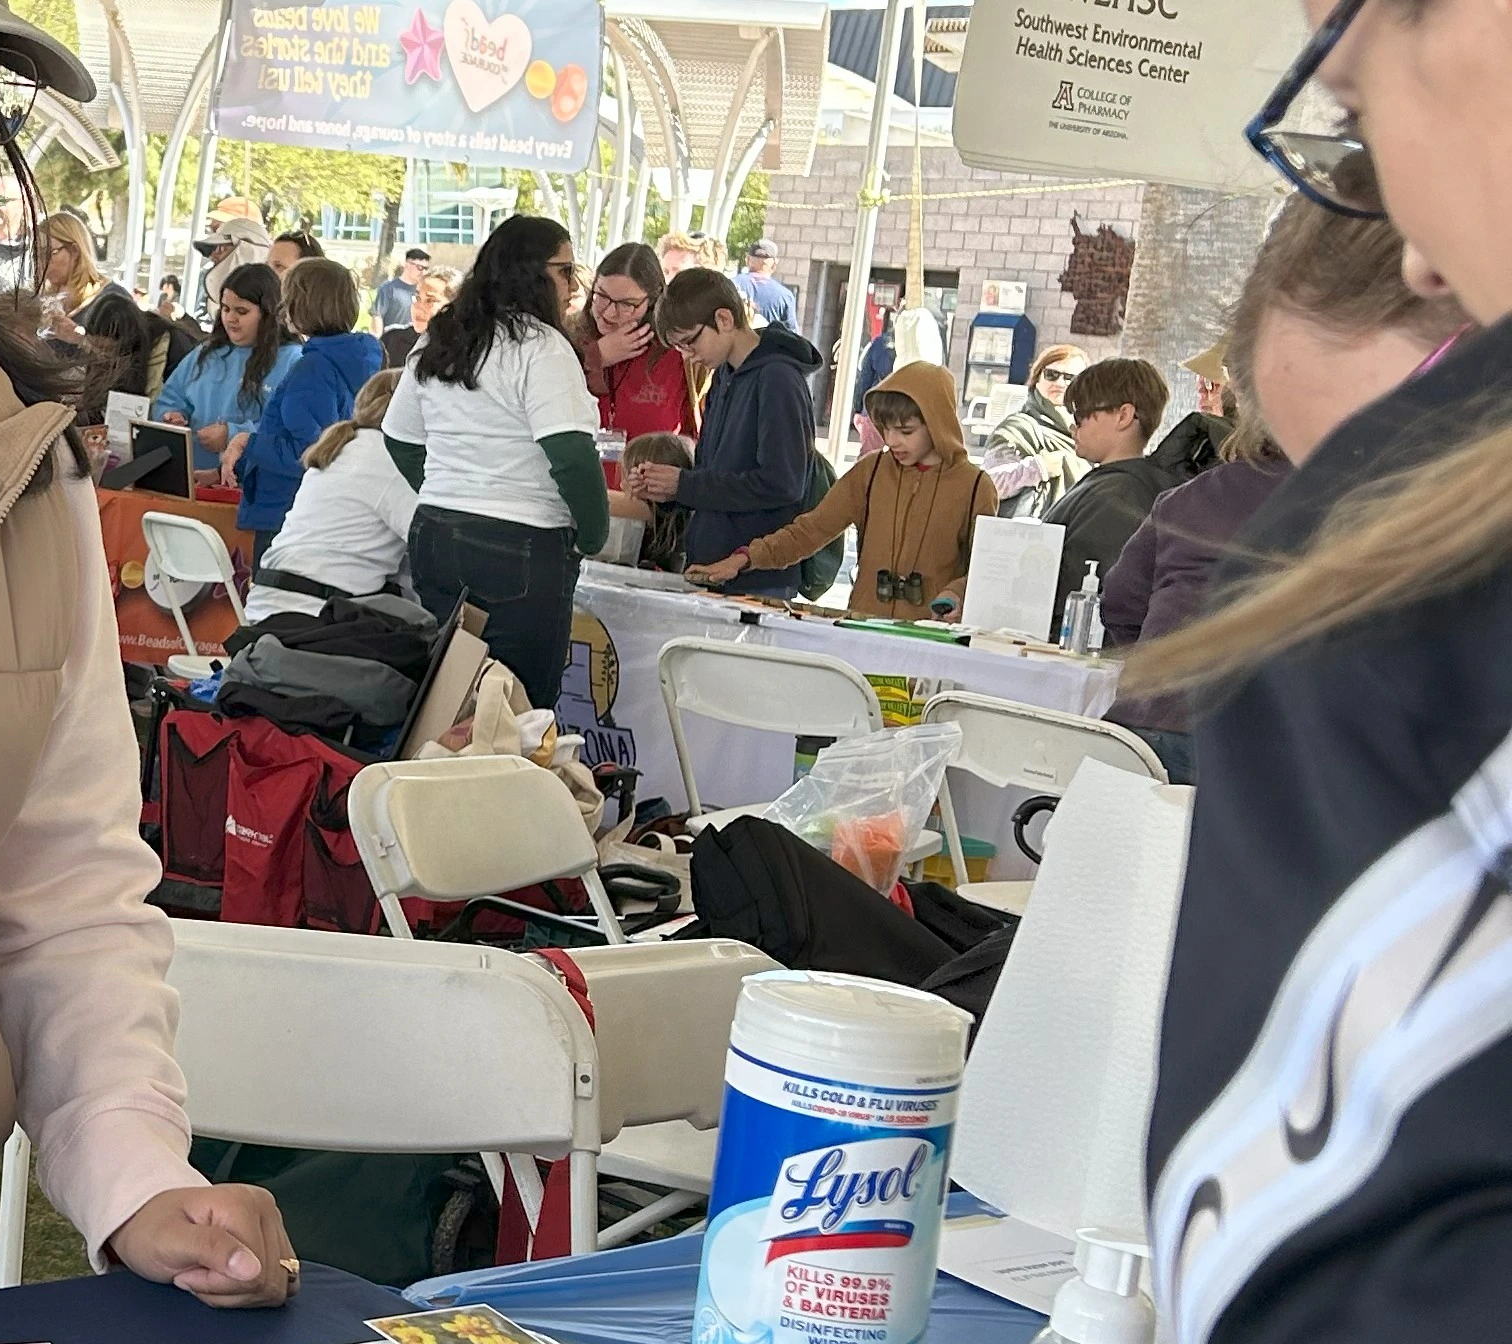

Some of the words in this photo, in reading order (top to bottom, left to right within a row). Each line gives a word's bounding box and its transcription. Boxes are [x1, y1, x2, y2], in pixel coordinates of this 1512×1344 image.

[1014, 8, 1088, 41] Southwest
[1092, 23, 1203, 61] Environmental
[1015, 35, 1063, 64] Health
[1066, 46, 1133, 76] Sciences
[1138, 58, 1190, 84] Center
[1077, 87, 1117, 104] COLLEGE
[1119, 95, 1132, 106] OF
[1078, 102, 1130, 120] PHARMACY
[782, 1081, 819, 1099] KILLS
[820, 1090, 856, 1106] COLD
[857, 1097, 865, 1108] &
[868, 1098, 895, 1111] FLU
[896, 1099, 940, 1112] VIRUSES
[780, 1143, 928, 1232] Lysol
[786, 1264, 834, 1286] KILLS
[840, 1276, 892, 1292] 99.9%
[785, 1280, 809, 1295] OF
[814, 1287, 889, 1305] VIRUSES
[782, 1295, 794, 1309] &
[799, 1298, 889, 1320] BACTERIA
[780, 1316, 887, 1341] DISINFECTING
